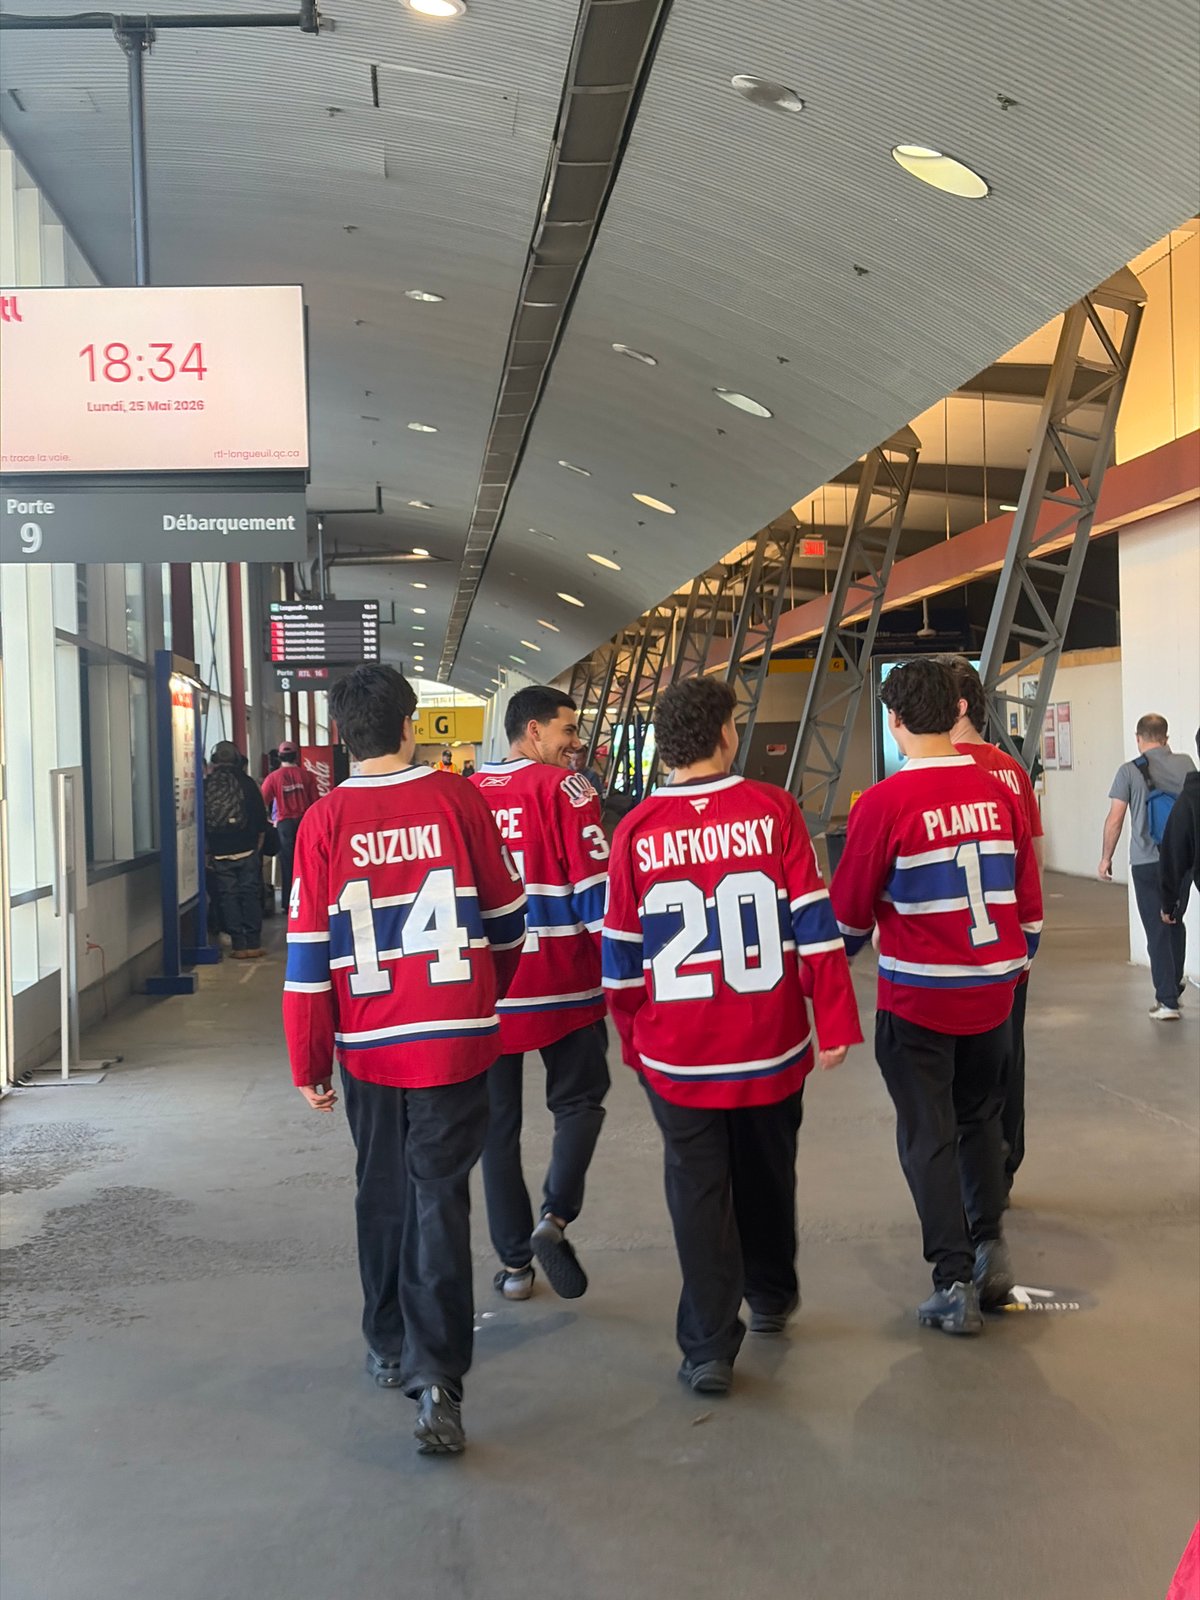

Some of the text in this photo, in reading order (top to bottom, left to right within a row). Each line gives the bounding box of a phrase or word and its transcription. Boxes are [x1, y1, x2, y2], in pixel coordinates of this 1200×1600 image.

[79, 342, 207, 382] 18:34
[87, 400, 205, 413] Lundi, 25 Mai 2026
[10, 453, 35, 462] trace
[37, 453, 47, 462] la
[213, 449, 300, 460] rtl-longueuil.qc.ca
[6, 498, 55, 515] Porte
[20, 522, 43, 554] 9
[162, 513, 296, 535] Débarquement
[281, 677, 290, 690] 8
[435, 716, 449, 735] G
[492, 807, 523, 840] CE
[922, 801, 1001, 841] PLANTE
[350, 823, 442, 867] SUZUKI
[636, 814, 774, 873] SLAFKOVSKÝ
[955, 839, 1001, 948] 1
[336, 865, 473, 999] 14
[642, 870, 785, 1005] 20
